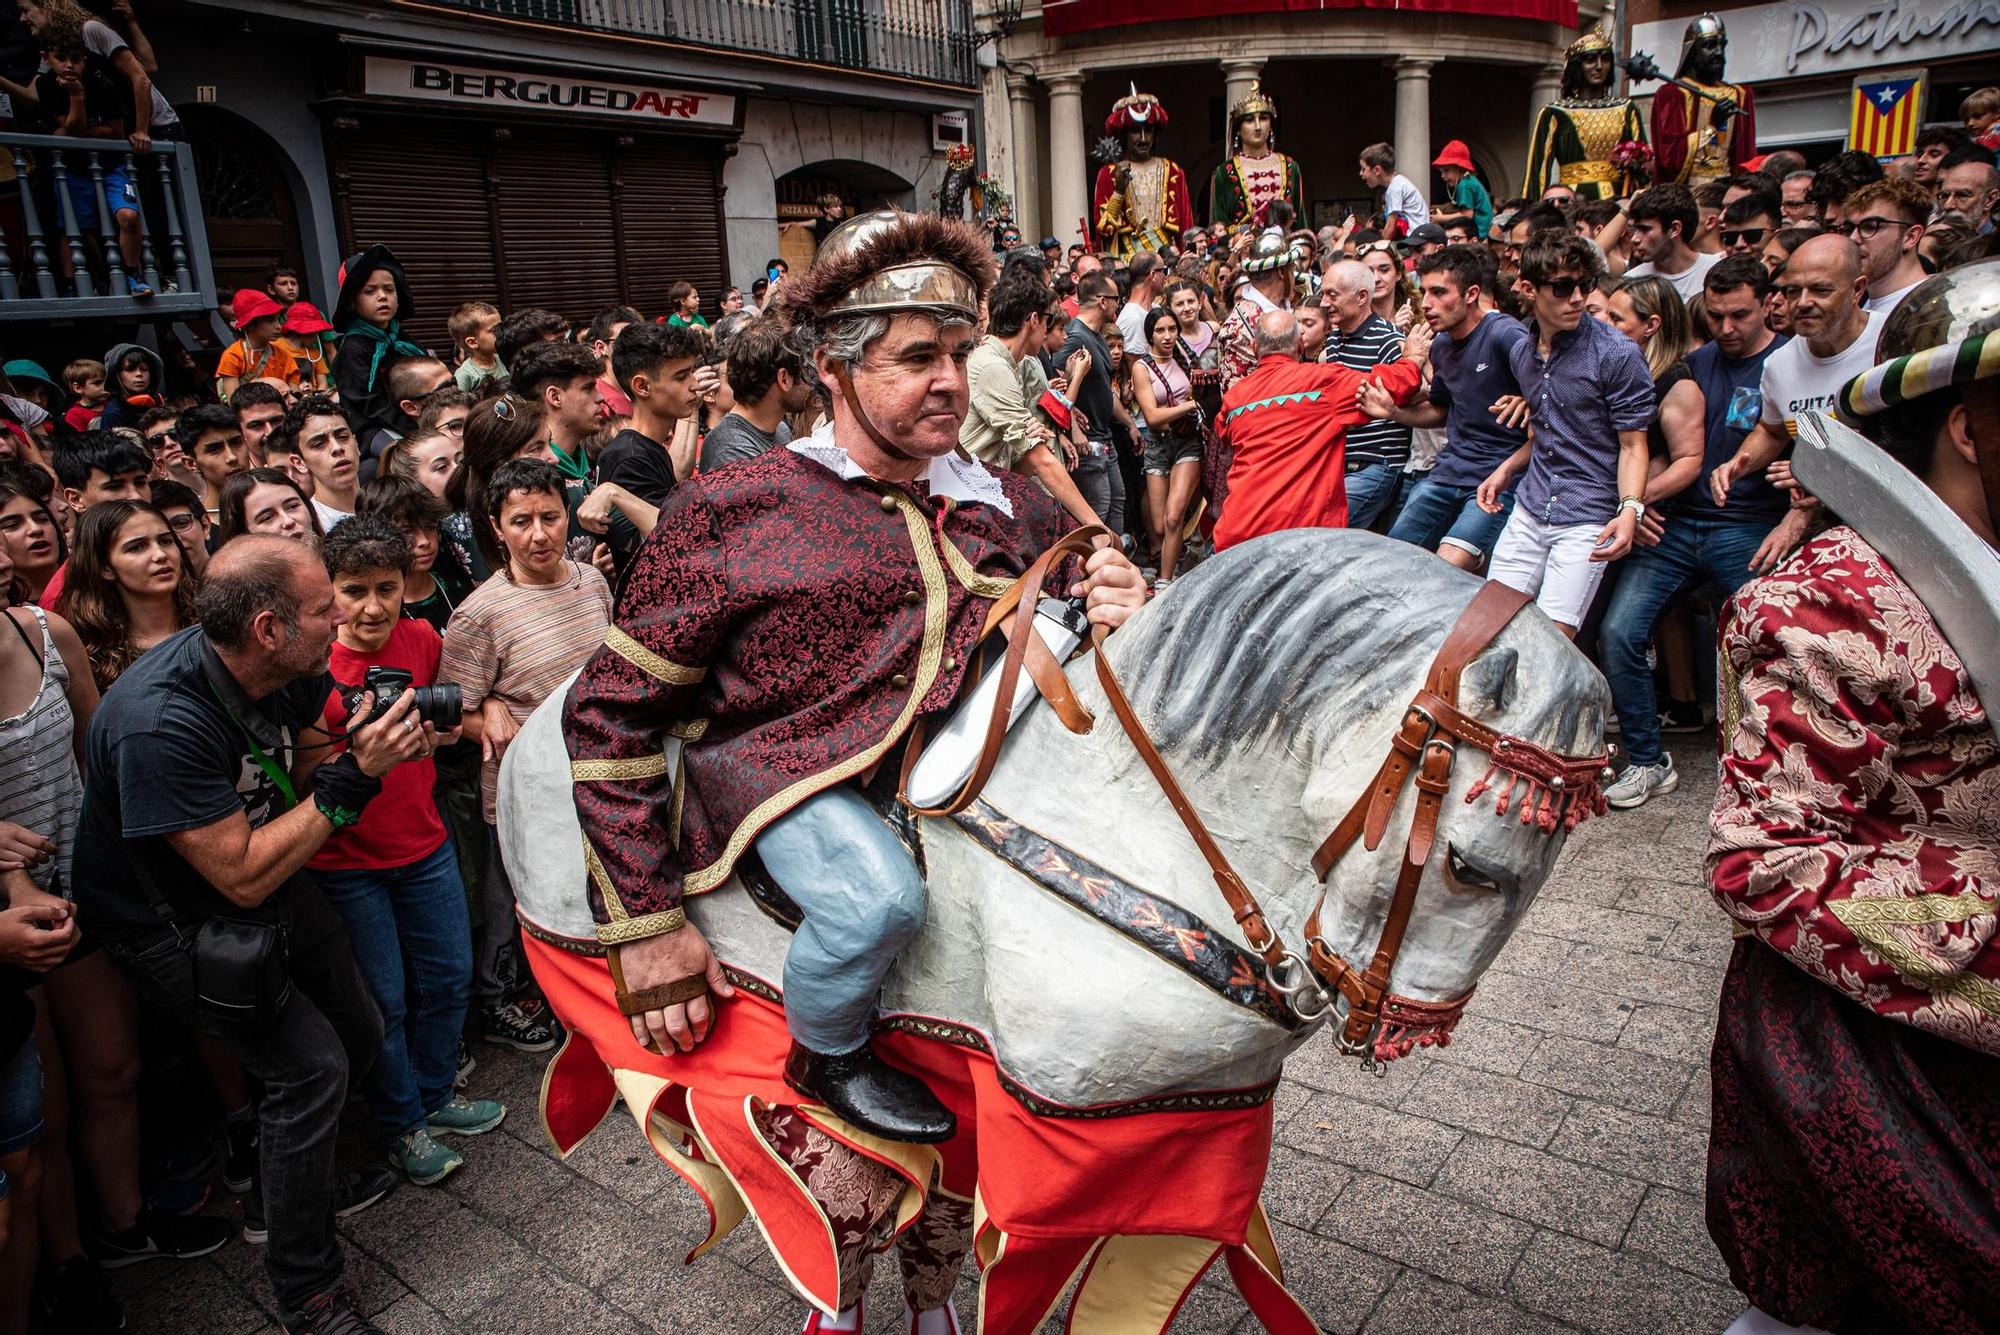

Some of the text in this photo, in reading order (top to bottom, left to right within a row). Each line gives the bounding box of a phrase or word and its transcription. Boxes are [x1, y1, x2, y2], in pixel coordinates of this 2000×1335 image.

[200, 87, 213, 101] 11
[410, 64, 706, 118] BERGUEDART
[781, 205, 802, 214] PIZZA
